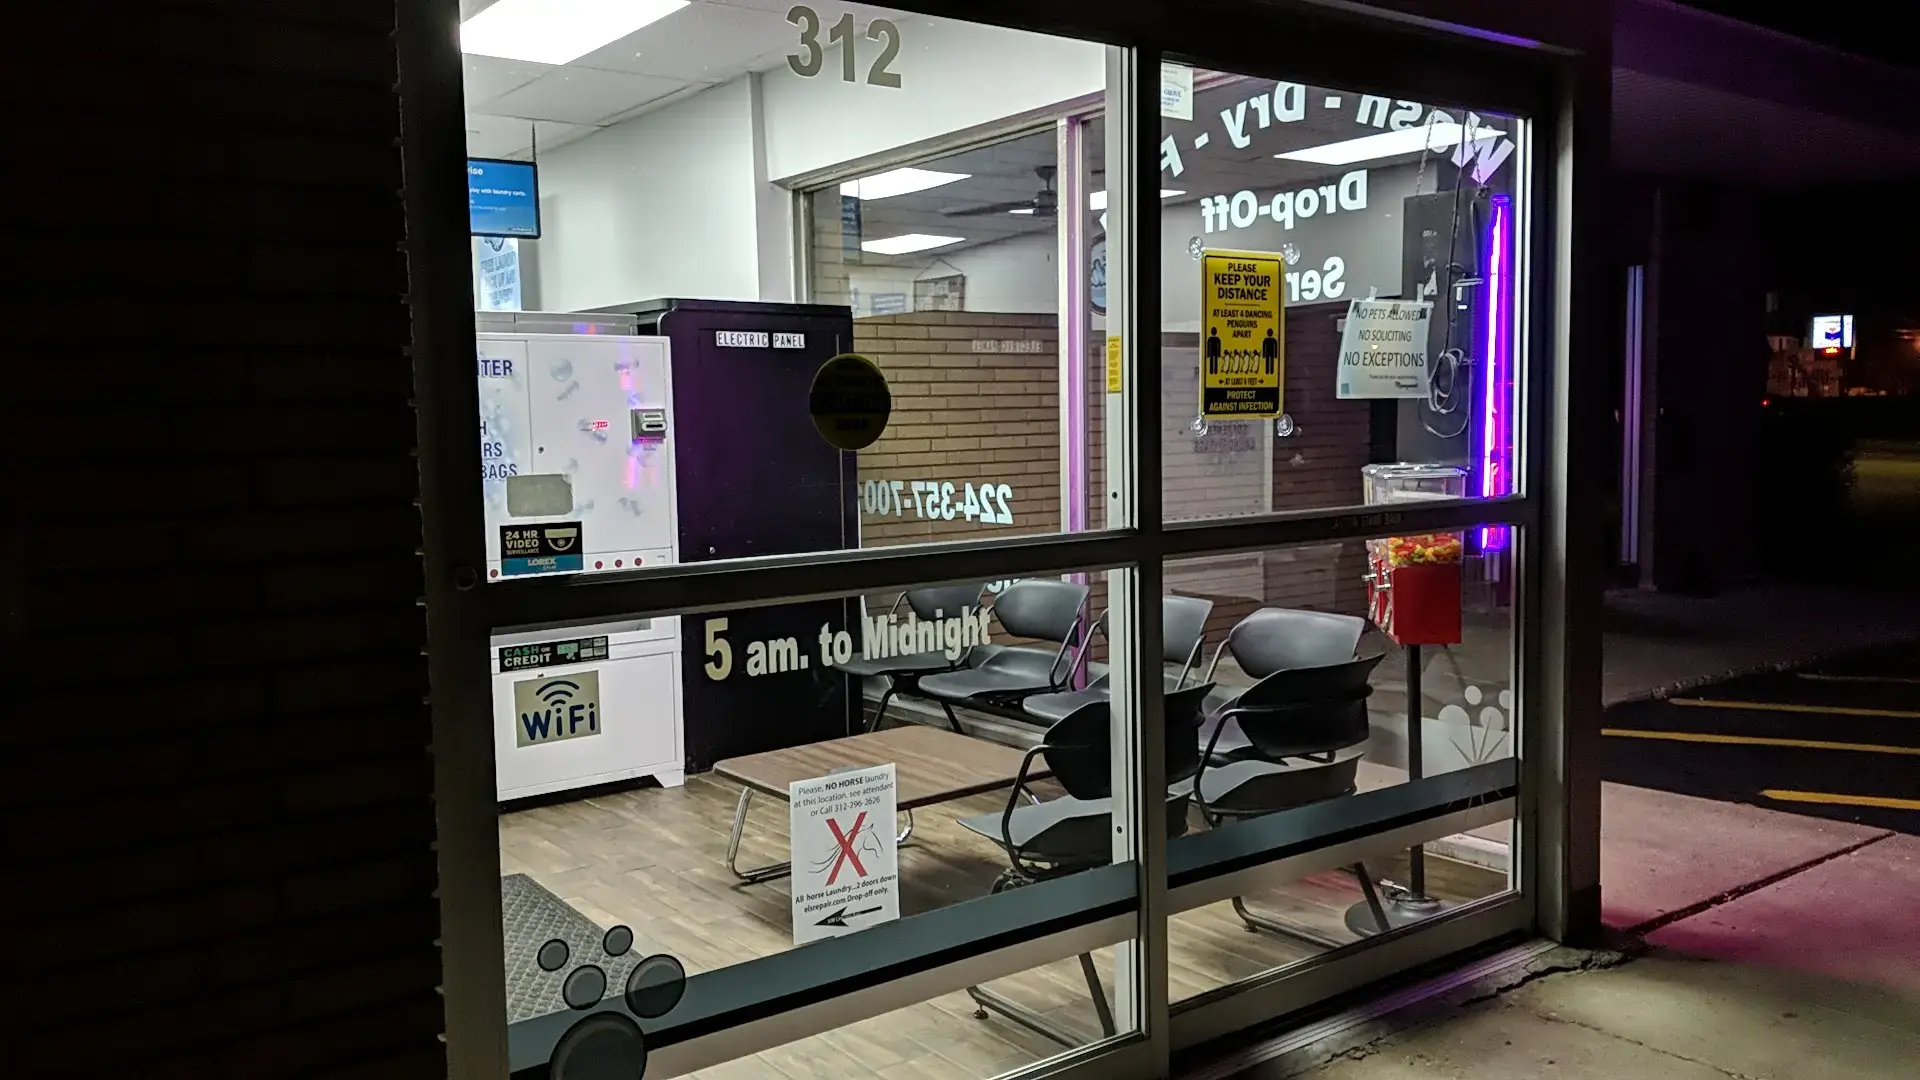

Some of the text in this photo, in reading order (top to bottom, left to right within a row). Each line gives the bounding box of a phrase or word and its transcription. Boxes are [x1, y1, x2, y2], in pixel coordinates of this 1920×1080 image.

[786, 5, 902, 89] 312
[1227, 262, 1257, 273] PLEASE
[1214, 273, 1271, 288] KEEP YOUR
[1217, 287, 1268, 301] DISTANCE
[1212, 309, 1273, 319] AT LEAST 4 DANCING
[1355, 308, 1421, 321] NO PETS ALLOWED
[1227, 320, 1258, 329] PENGUINS
[717, 332, 804, 347] ELECTRIC PANEL
[1232, 330, 1252, 339] APART
[1358, 329, 1412, 342] NO SOLICITING
[1343, 351, 1425, 367] NO EXCEPTIONS
[478, 359, 513, 376] TER
[1226, 390, 1256, 400] PROTECT
[1209, 400, 1274, 412] AGAINST INFECTION
[505, 530, 520, 540] 24
[505, 538, 540, 549] VIDEO
[704, 606, 991, 681] 5 am. to Midnight
[504, 645, 540, 658] CASH
[503, 652, 552, 667] CREDIT
[521, 702, 595, 741] WiFi
[825, 782, 838, 791] NO
[839, 776, 864, 788] HORSE
[865, 772, 890, 783] laundry
[804, 796, 817, 807] this
[862, 782, 894, 796] attendant
[819, 805, 833, 815] Call
[795, 896, 805, 904] All
[806, 891, 825, 901] horse
[861, 878, 879, 888] doors
[880, 873, 897, 883] down
[803, 897, 846, 913] elsrepair.com
[846, 888, 873, 903] Drop-off
